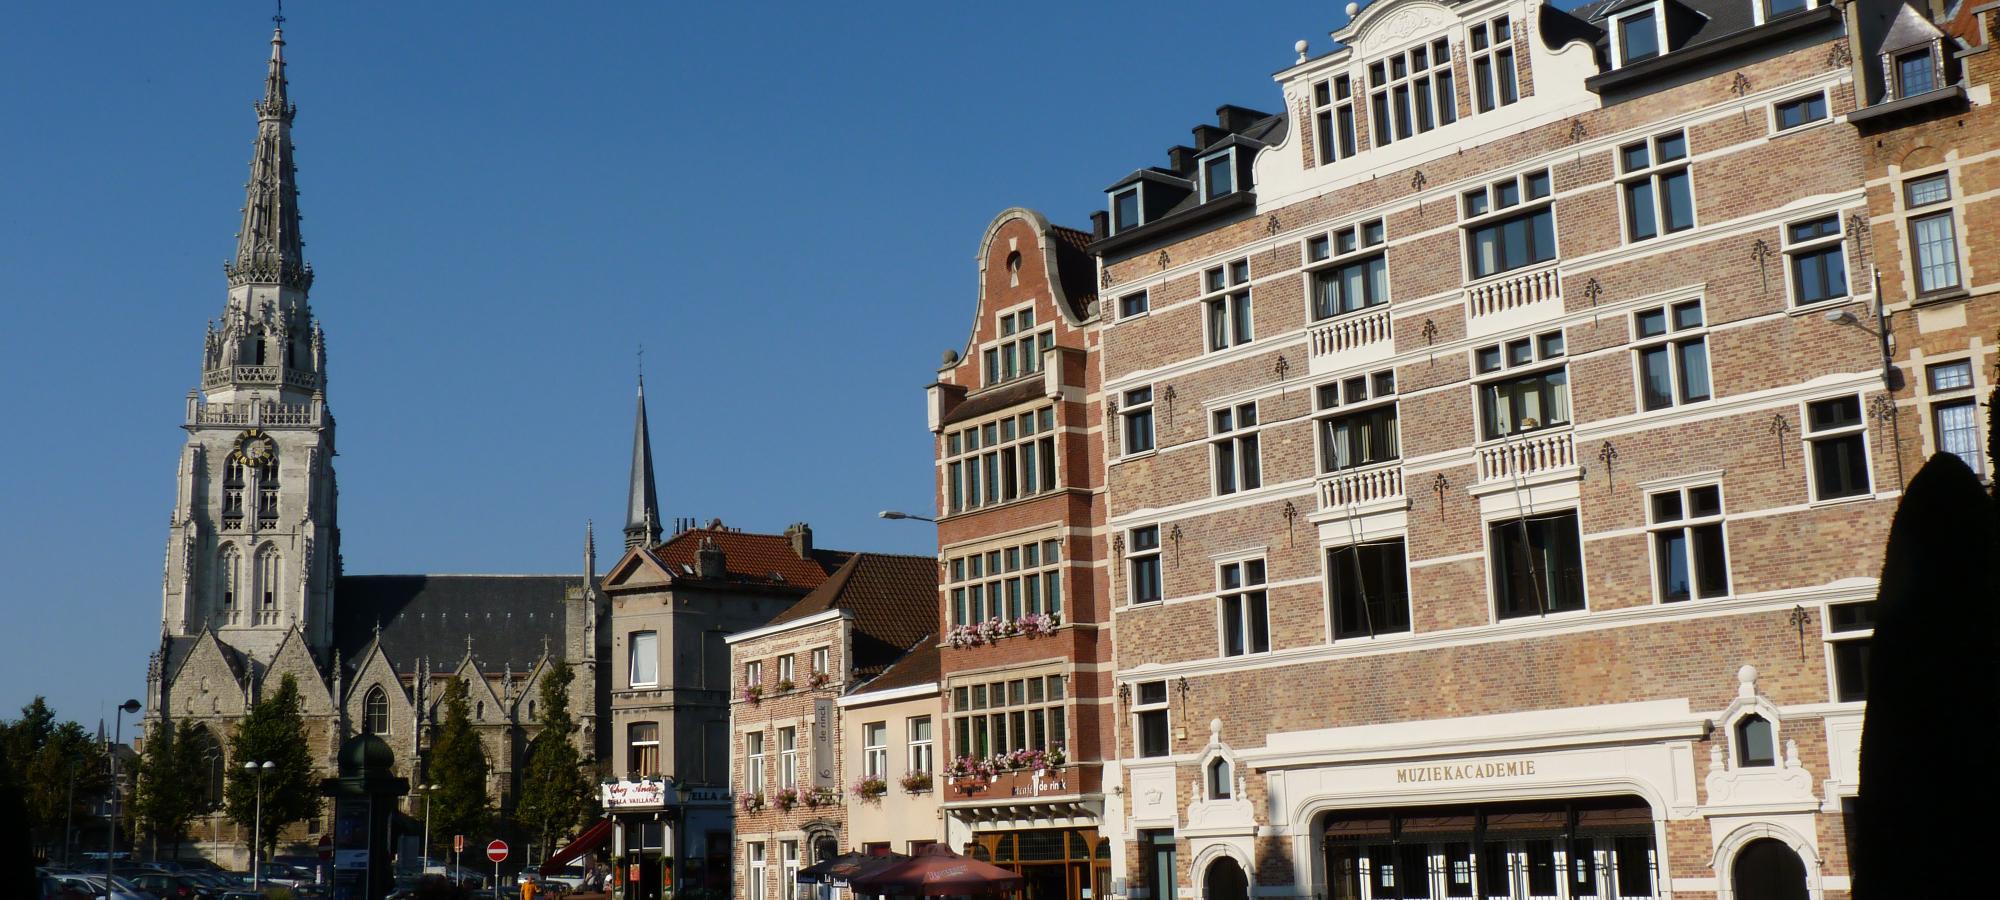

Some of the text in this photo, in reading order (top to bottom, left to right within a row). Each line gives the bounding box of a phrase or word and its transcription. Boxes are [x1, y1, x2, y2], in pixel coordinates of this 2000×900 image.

[818, 705, 826, 741] de rinck
[1397, 760, 1536, 783] MUZIEKACADEMIE
[1039, 780, 1048, 791] de
[1050, 778, 1066, 790] rink
